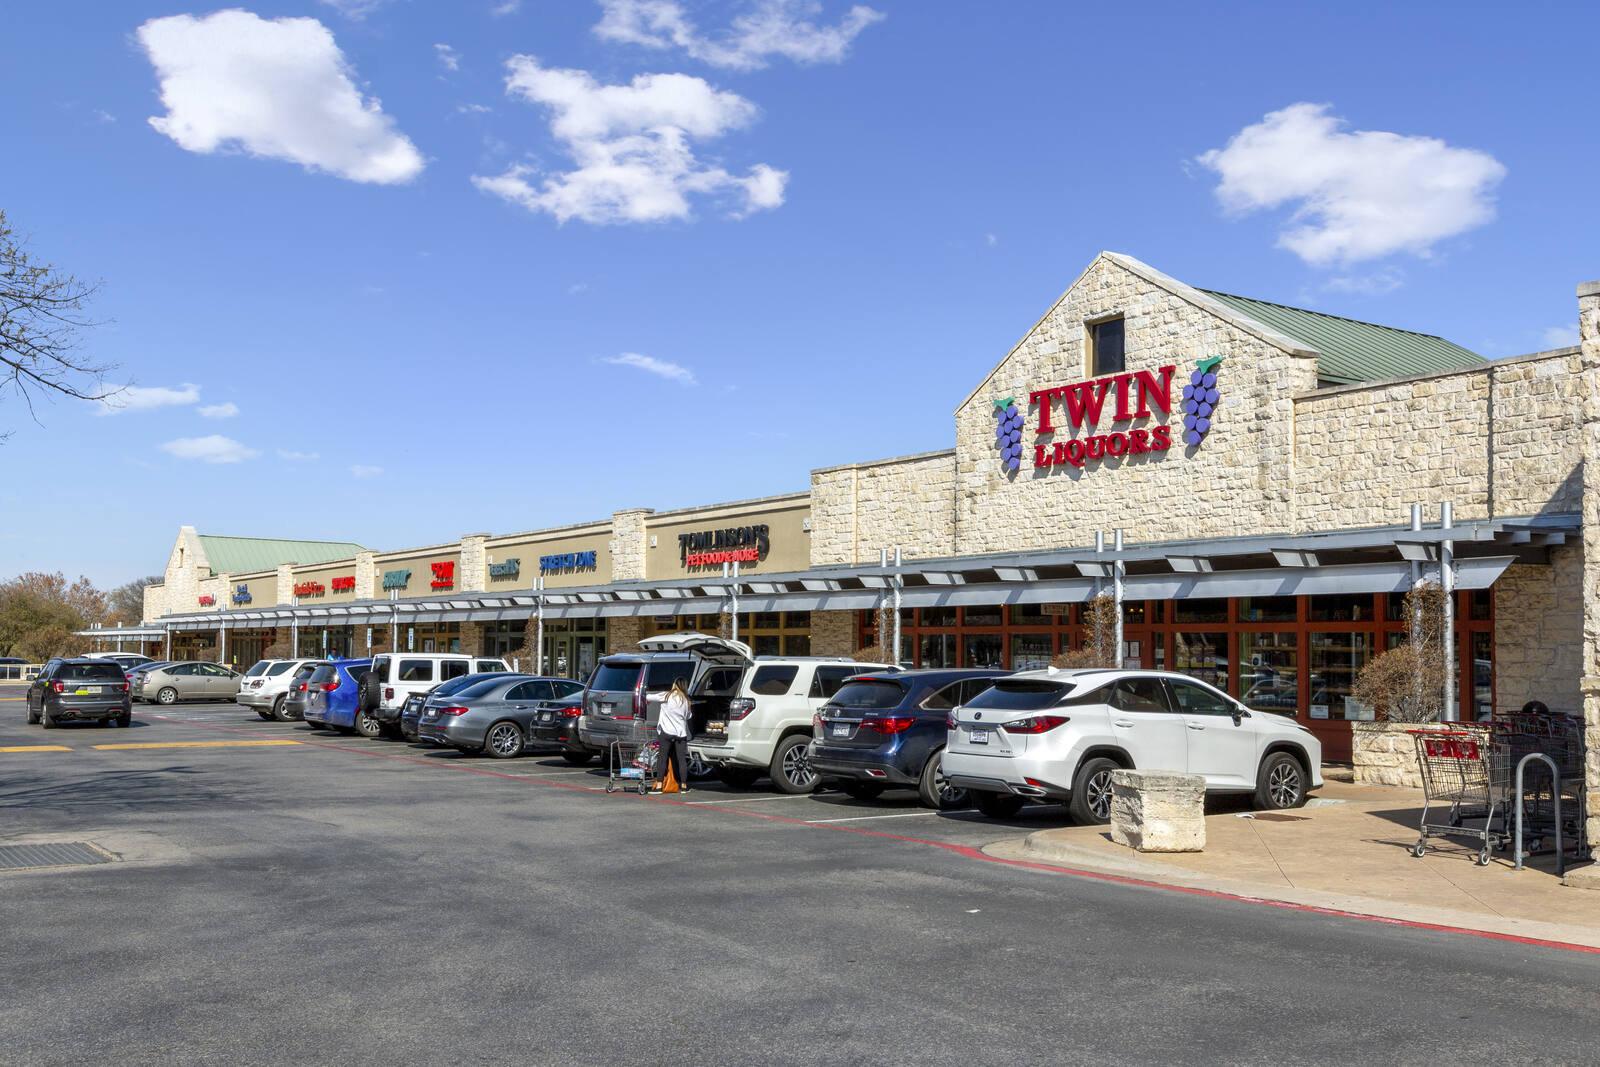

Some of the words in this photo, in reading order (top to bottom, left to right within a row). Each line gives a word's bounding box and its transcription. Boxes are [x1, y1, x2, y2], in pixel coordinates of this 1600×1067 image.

[1029, 365, 1176, 434] TWIN
[1034, 425, 1172, 467] LIQUORS
[539, 553, 575, 571] STRETCH
[575, 550, 597, 566] ZONE
[678, 524, 770, 561] TOMLINSON'S
[686, 552, 703, 566] PET
[703, 551, 724, 565] FOOD
[732, 548, 759, 562] MORE
